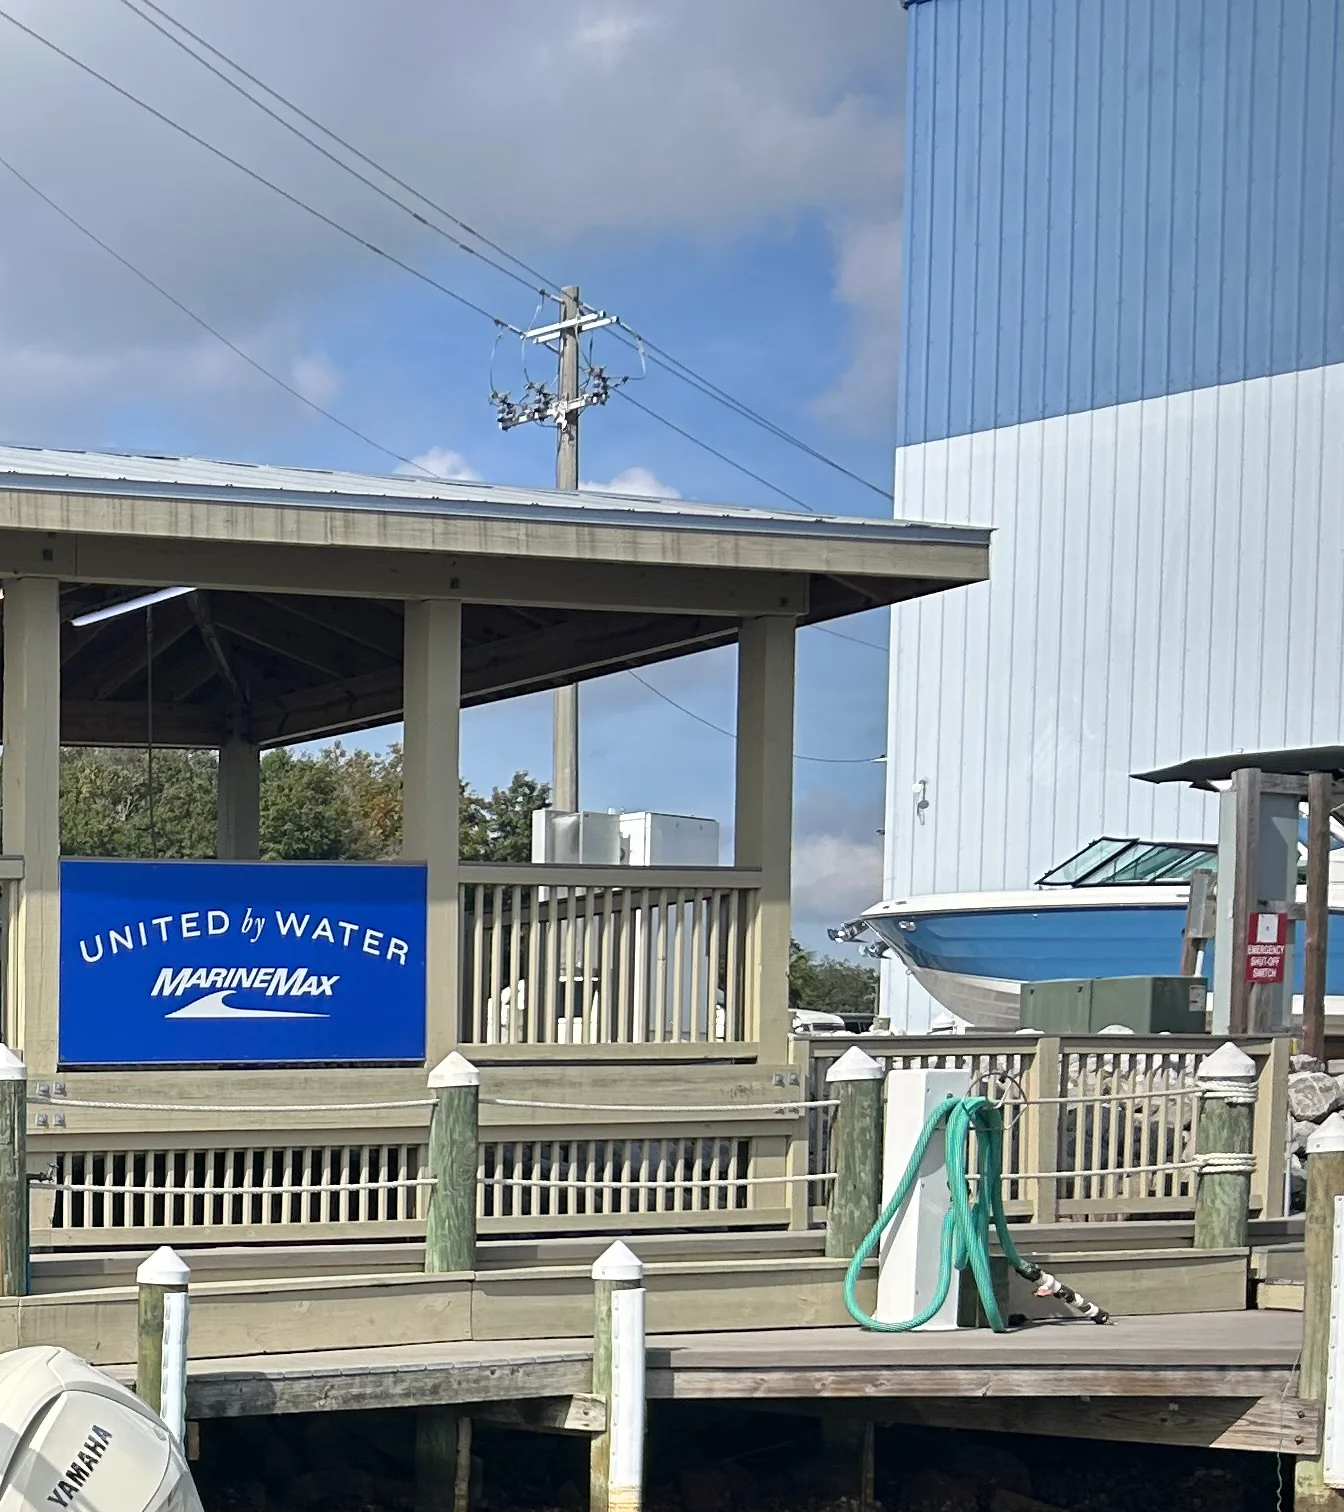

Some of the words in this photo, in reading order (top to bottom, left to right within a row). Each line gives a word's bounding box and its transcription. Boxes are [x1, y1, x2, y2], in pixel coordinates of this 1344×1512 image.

[79, 909, 230, 964] UNITED
[241, 907, 266, 943] by
[275, 910, 410, 966] WATER
[1250, 956, 1280, 967] SHUT-OFF
[1252, 967, 1277, 978] SWITCH
[47, 1424, 113, 1508] YAMAHA
